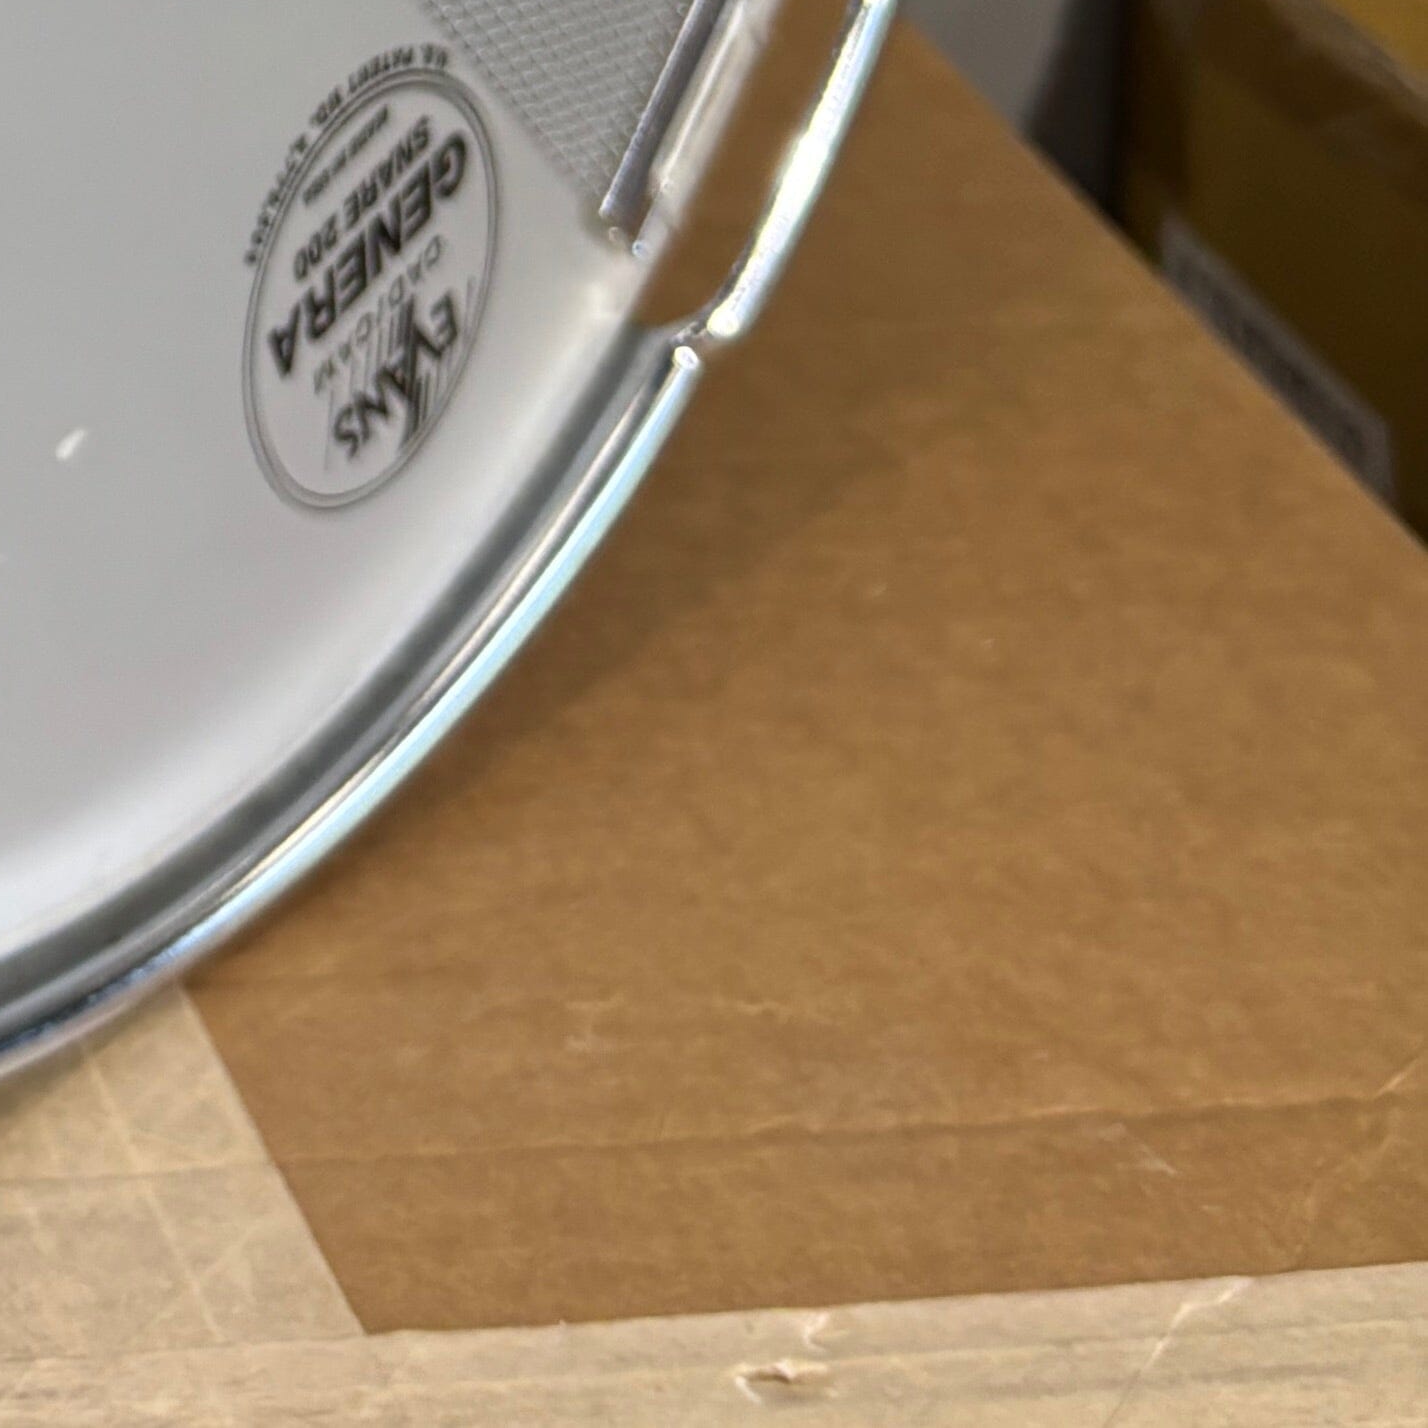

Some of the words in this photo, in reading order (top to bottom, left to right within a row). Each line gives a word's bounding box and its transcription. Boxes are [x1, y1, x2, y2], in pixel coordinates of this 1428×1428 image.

[343, 115, 430, 230] SNARE
[268, 130, 467, 378] GENERA
[293, 213, 338, 282] 200
[334, 292, 458, 461] EVANS
